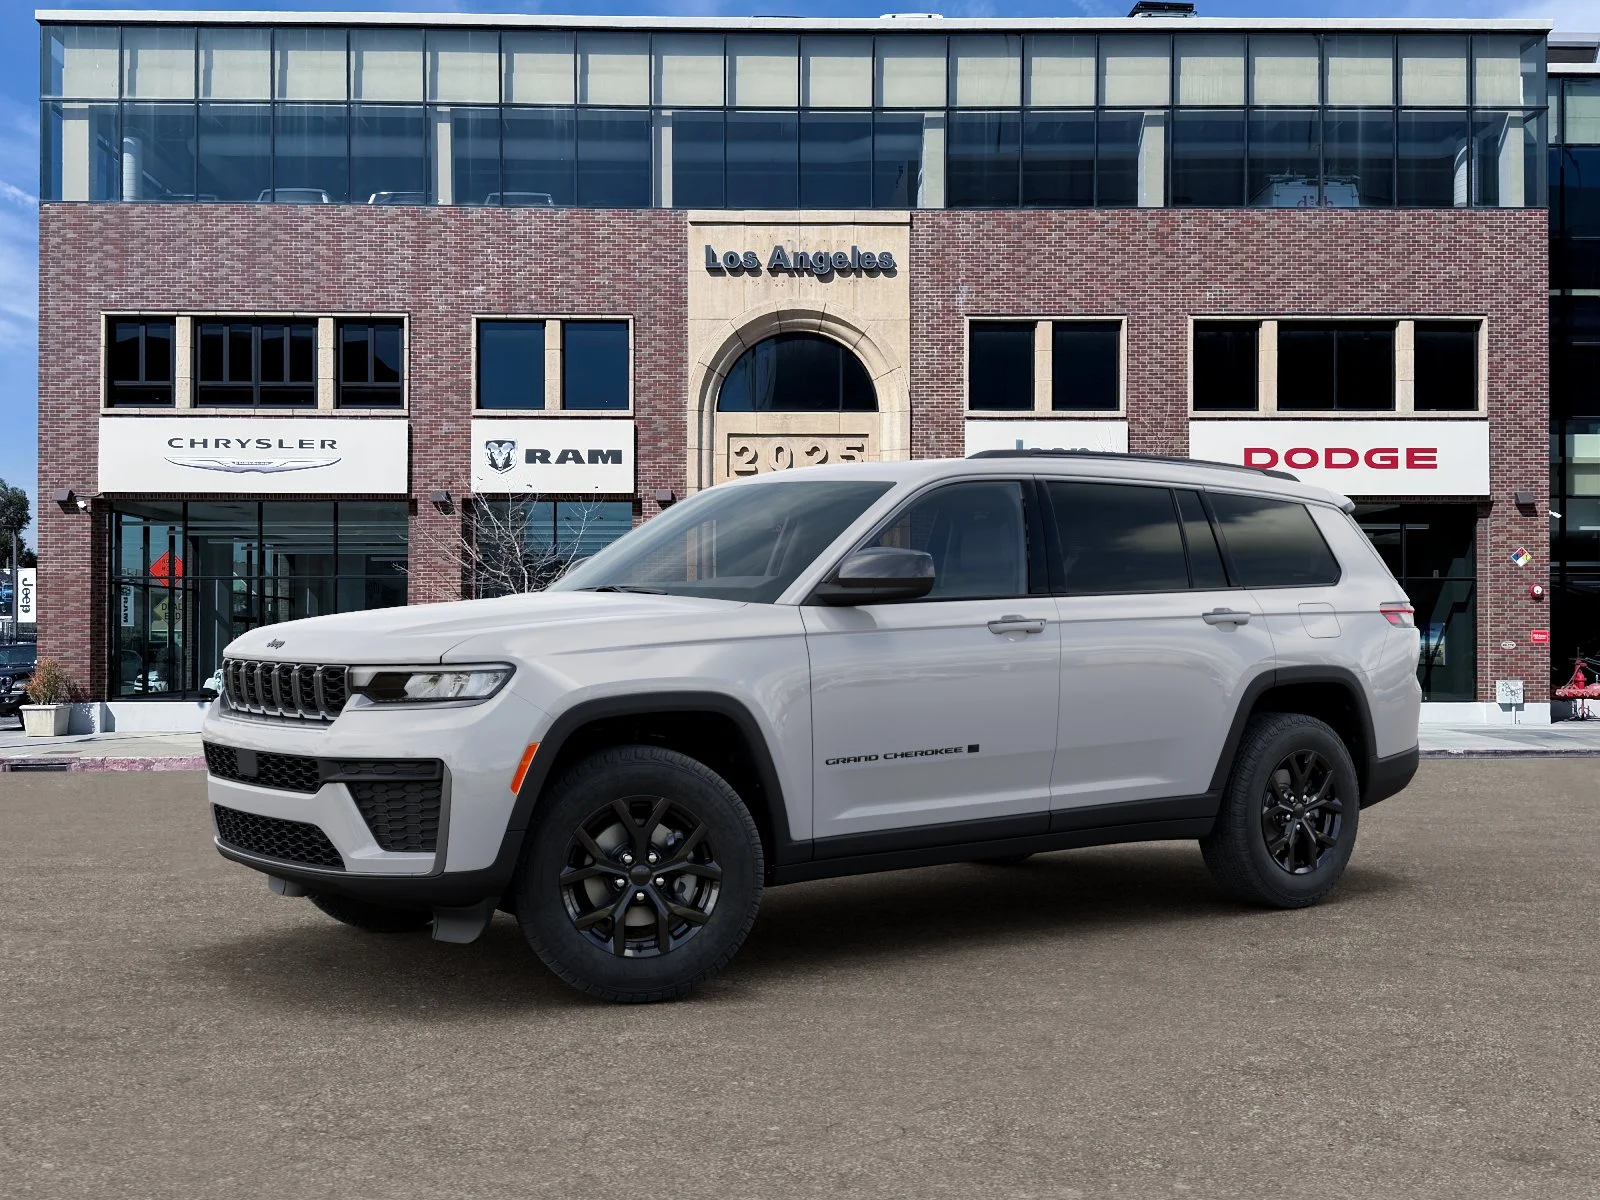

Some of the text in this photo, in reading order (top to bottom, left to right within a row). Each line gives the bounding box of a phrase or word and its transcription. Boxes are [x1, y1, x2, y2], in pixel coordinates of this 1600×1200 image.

[1297, 195, 1334, 208] dih
[704, 244, 896, 275] Los Angeles
[168, 437, 338, 450] CHRYSLER
[524, 448, 623, 465] RAM
[734, 441, 866, 473] 2025
[1243, 447, 1438, 470] DODGE
[19, 577, 34, 614] Jeep
[161, 602, 183, 611] DD
[164, 612, 181, 620] ED
[825, 746, 964, 766] GRAND CHEROKEE
